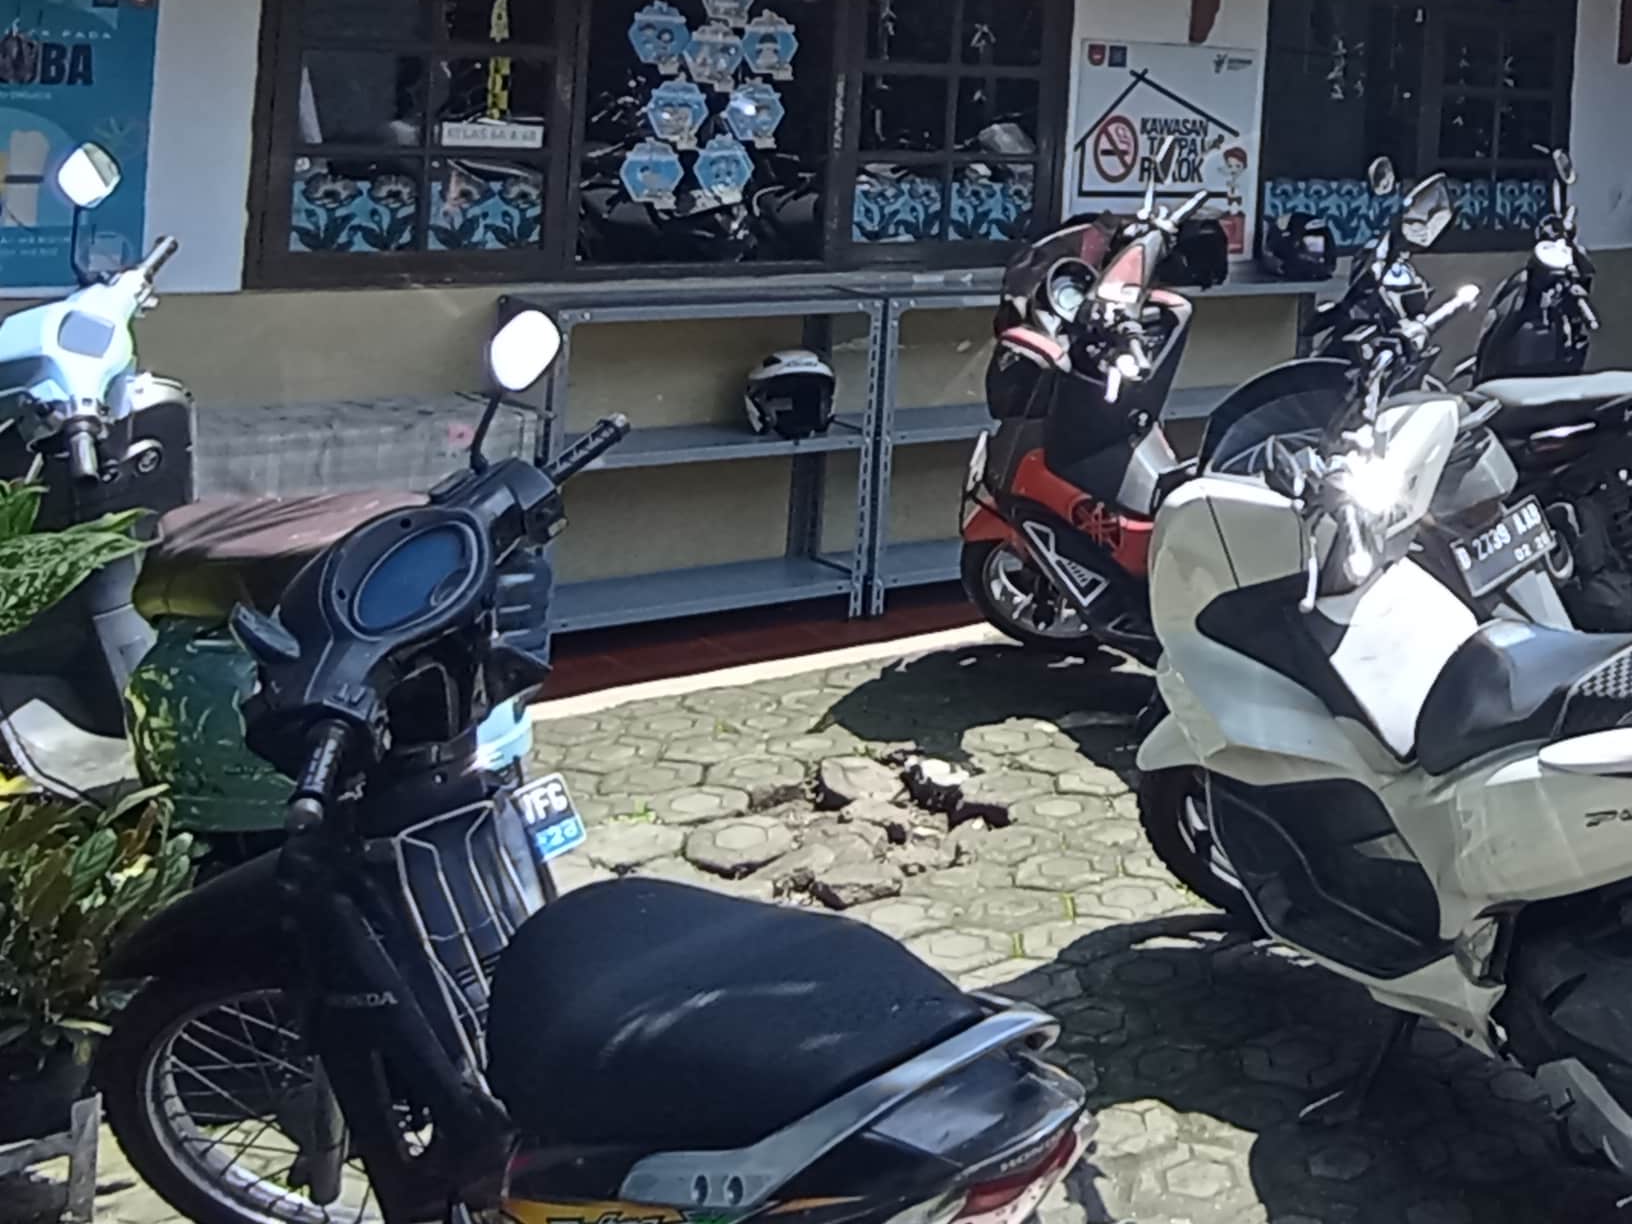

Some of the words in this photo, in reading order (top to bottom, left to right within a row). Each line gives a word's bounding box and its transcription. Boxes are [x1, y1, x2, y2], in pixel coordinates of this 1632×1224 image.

[1140, 117, 1209, 137] KAWASAN
[1455, 546, 1472, 570] D
[1471, 523, 1512, 561] 2739
